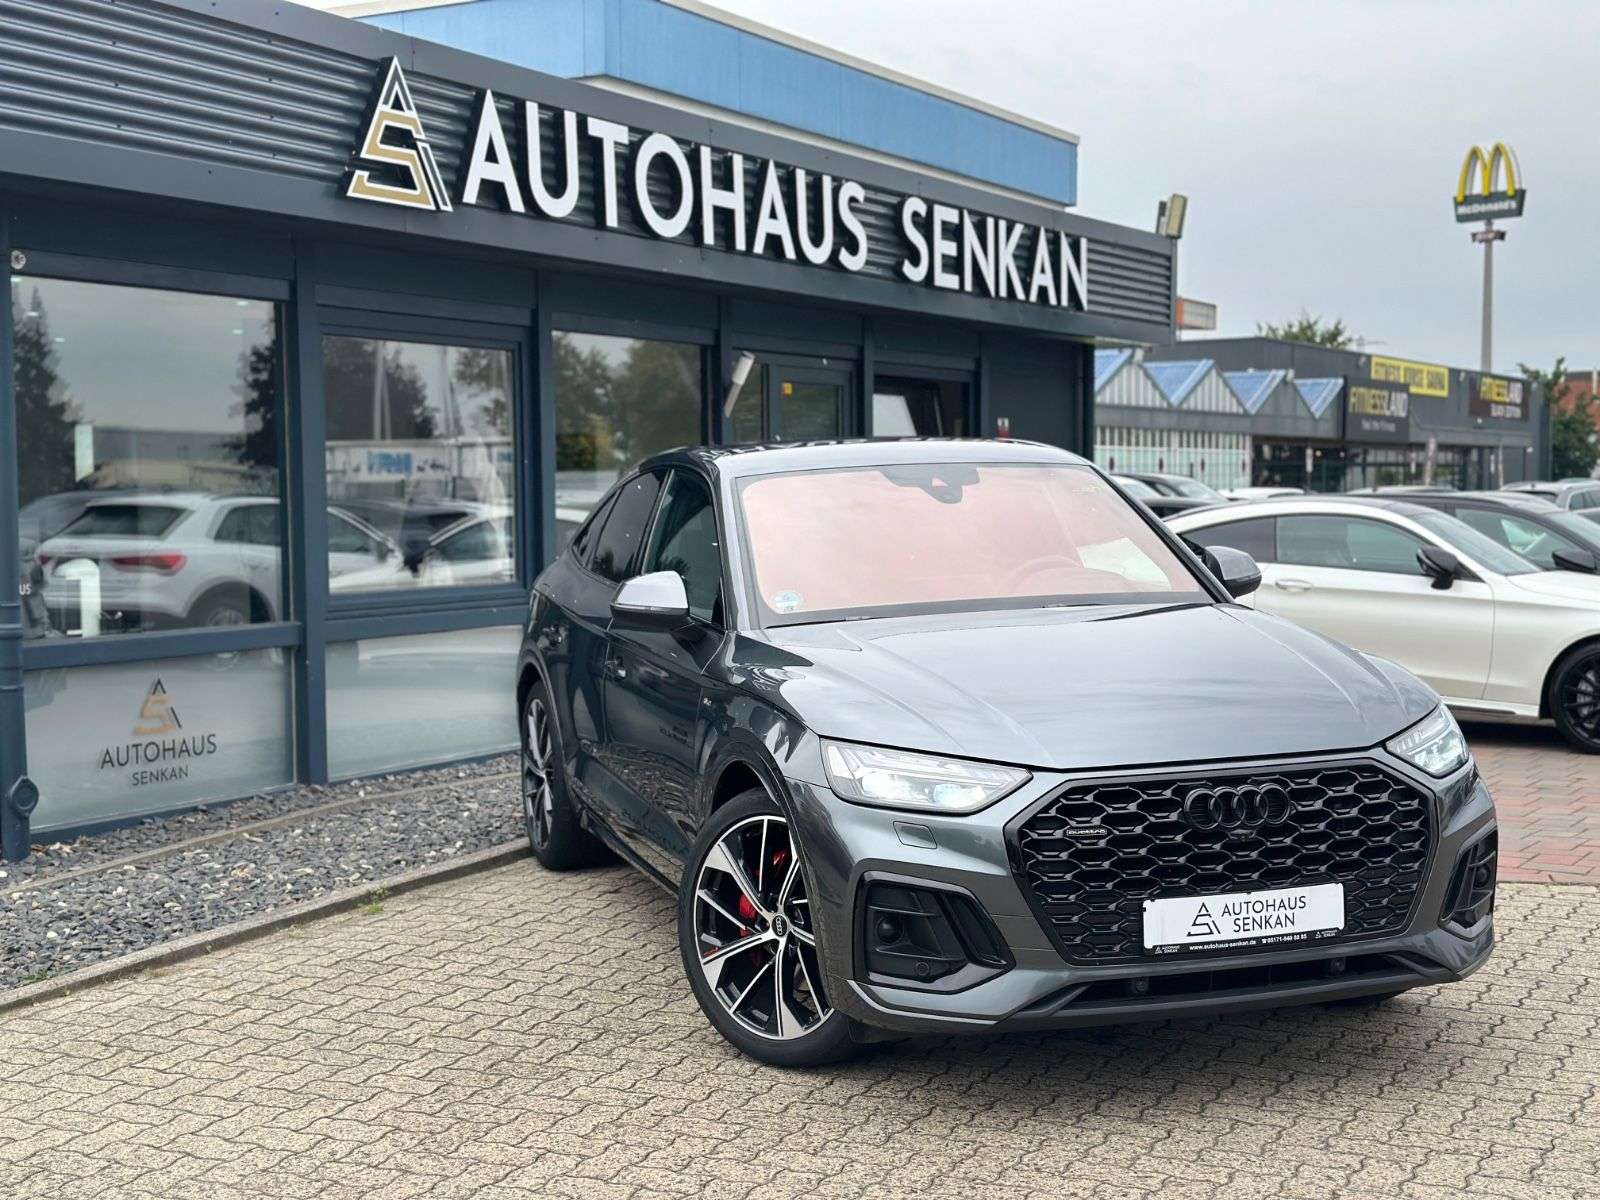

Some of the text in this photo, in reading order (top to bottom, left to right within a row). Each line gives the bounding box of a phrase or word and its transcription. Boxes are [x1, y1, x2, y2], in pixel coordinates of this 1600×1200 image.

[462, 88, 1088, 311] AUTOHAUS SENKAN
[100, 733, 217, 770] AUTOHAUS
[131, 765, 188, 786] SENKAN
[1221, 895, 1306, 917] AUTOHAUS
[1233, 912, 1295, 933] SENKAN
[1189, 940, 1257, 950] www.autohaus-senkan.de
